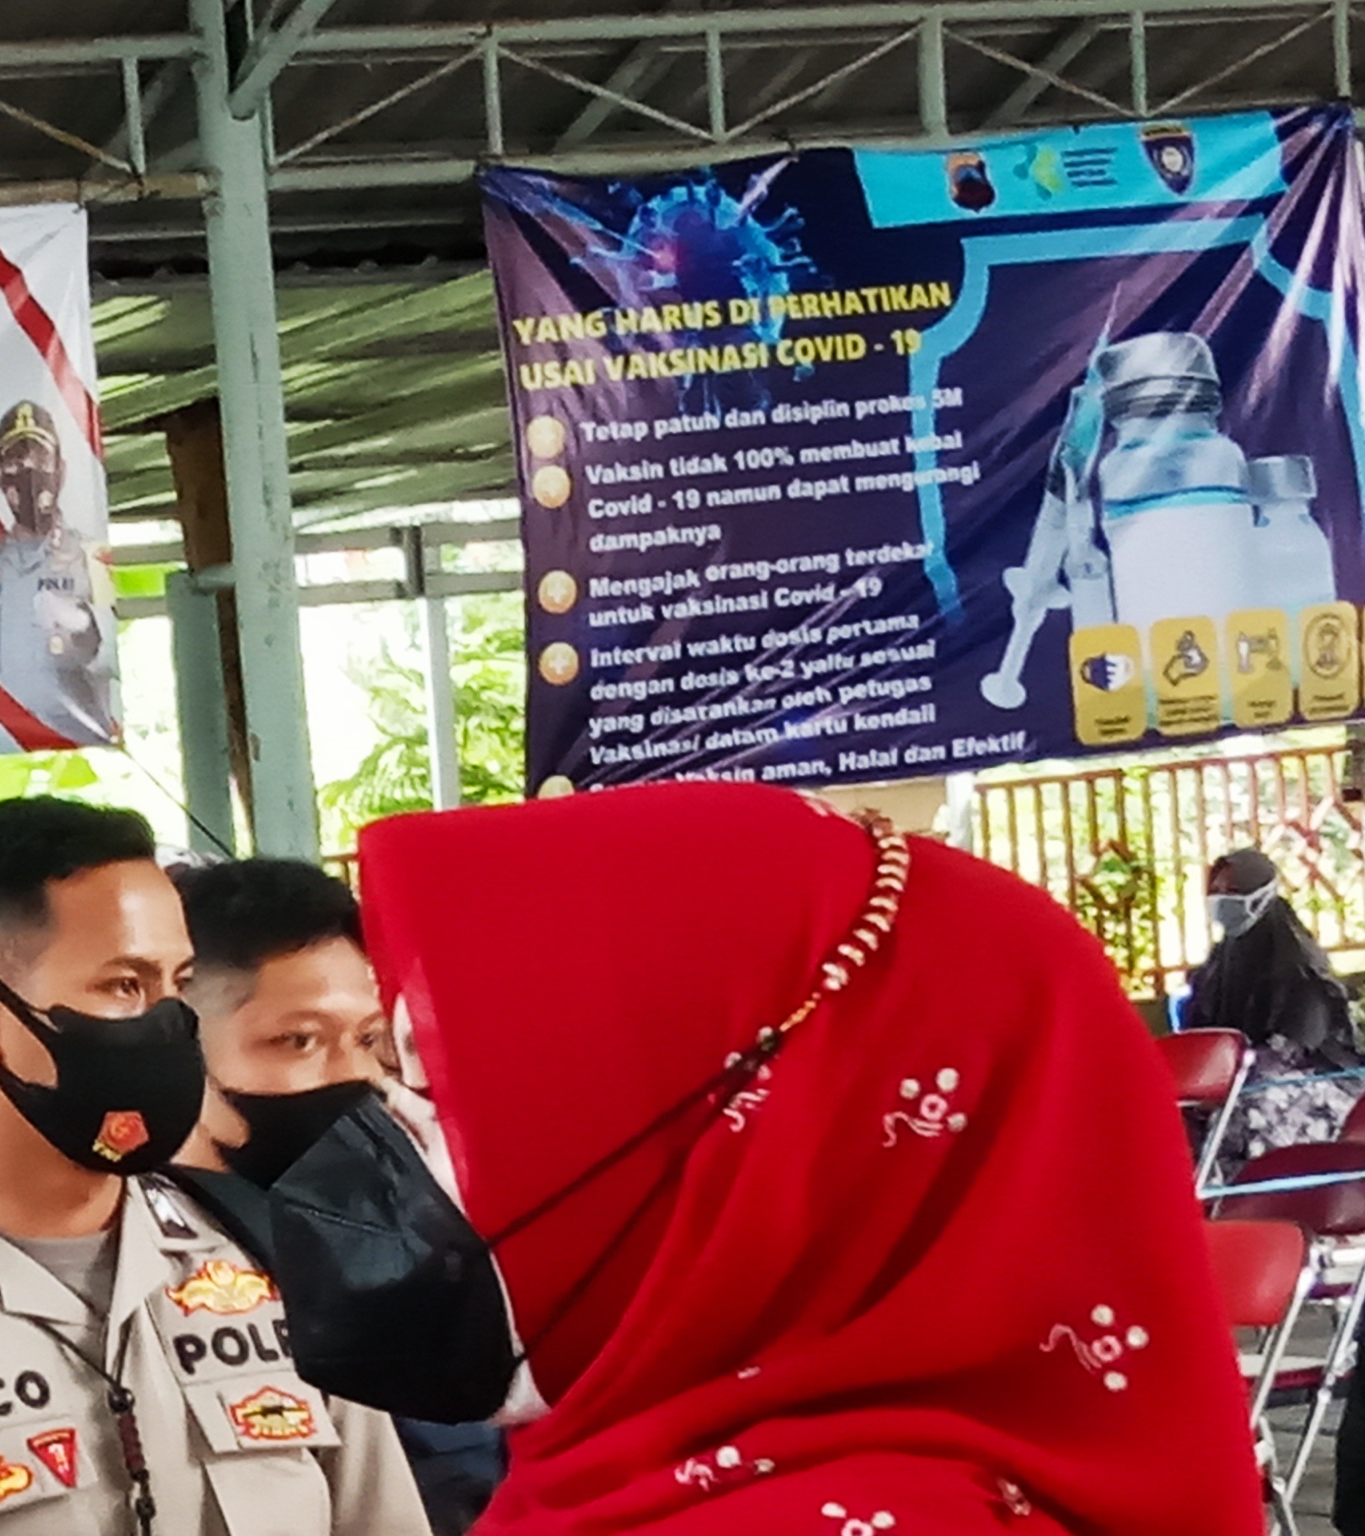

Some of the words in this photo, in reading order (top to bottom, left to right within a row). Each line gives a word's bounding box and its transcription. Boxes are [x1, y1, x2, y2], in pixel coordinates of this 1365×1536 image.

[514, 312, 606, 345] YANG
[615, 300, 722, 334] HARUS
[729, 296, 760, 325] DI
[770, 282, 952, 321] PERHATIKAN
[520, 359, 595, 391] USAI
[604, 344, 769, 382] VAKSINASI
[776, 334, 866, 366] COVID
[891, 328, 922, 355] 19
[580, 420, 648, 443] Tetap
[654, 412, 720, 438] patuh
[725, 407, 765, 428] dan
[771, 398, 850, 425] disiplin
[855, 394, 926, 420] prokes
[586, 460, 663, 485] Vaksin
[670, 454, 727, 477] tidak
[734, 446, 794, 470] 100%
[800, 437, 900, 464] membuat
[588, 494, 652, 519] Covid
[672, 490, 700, 509] 19
[707, 485, 781, 506] namun
[788, 476, 849, 500] dapat
[590, 524, 721, 552] dampaknya
[589, 571, 700, 598] Mengajak
[705, 553, 839, 581] orang-orang
[589, 606, 654, 627] untuk
[662, 590, 768, 619] vaksinasi
[774, 583, 836, 607] Covid
[591, 643, 681, 668] Interval
[688, 633, 756, 657] waktu
[762, 627, 822, 649] dosis
[826, 615, 919, 645] pertama
[590, 675, 674, 701] dengan
[681, 666, 739, 690] dosis
[745, 659, 795, 683] ke-2
[860, 639, 936, 667] sesuai
[589, 713, 644, 738] yang
[839, 675, 932, 703] petugas
[784, 716, 847, 741] kartu
[854, 703, 936, 731] kendali
[761, 758, 831, 782] aman,
[838, 748, 898, 774] Halal
[904, 741, 945, 764] dan
[952, 731, 1026, 758] Efektif
